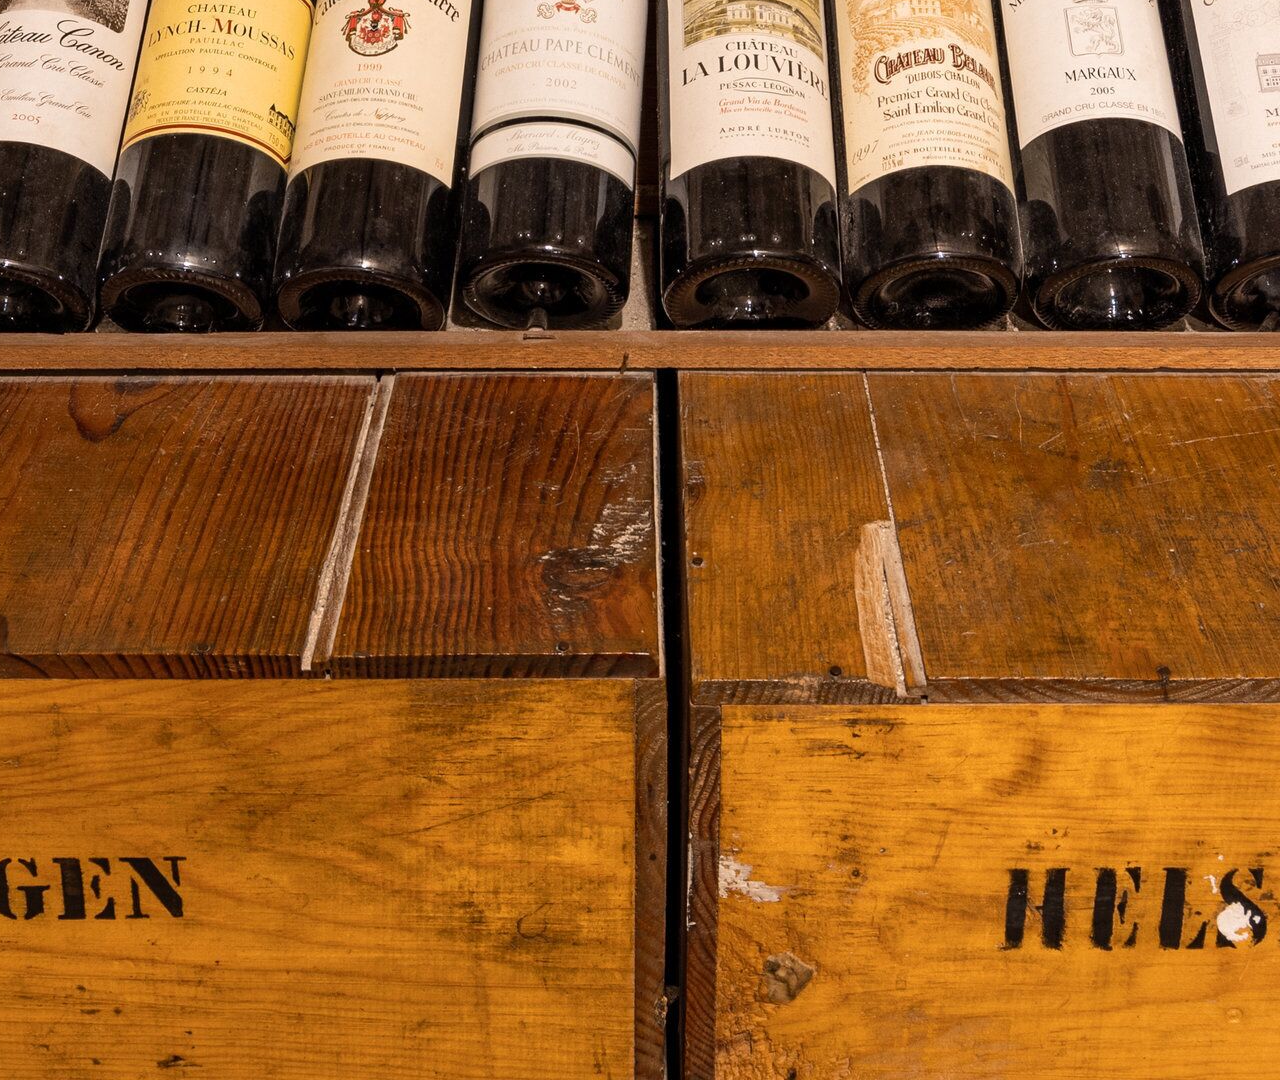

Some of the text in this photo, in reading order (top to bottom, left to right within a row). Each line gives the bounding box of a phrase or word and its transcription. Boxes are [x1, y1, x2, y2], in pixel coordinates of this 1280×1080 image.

[188, 3, 256, 18] CHATEAU
[57, 20, 125, 71] Canon
[726, 39, 798, 57] CHÂTEAU
[545, 38, 583, 53] PAPE
[587, 42, 641, 87] CLÉMENT
[682, 53, 829, 101] LA LOUVIÈRE
[1064, 68, 1137, 83] MARGAUX
[186, 86, 228, 97] CASTÉJA
[545, 78, 577, 90] 2002
[1091, 86, 1115, 95] 2005
[877, 87, 960, 108] Premier Grand
[11, 113, 40, 125] 2005
